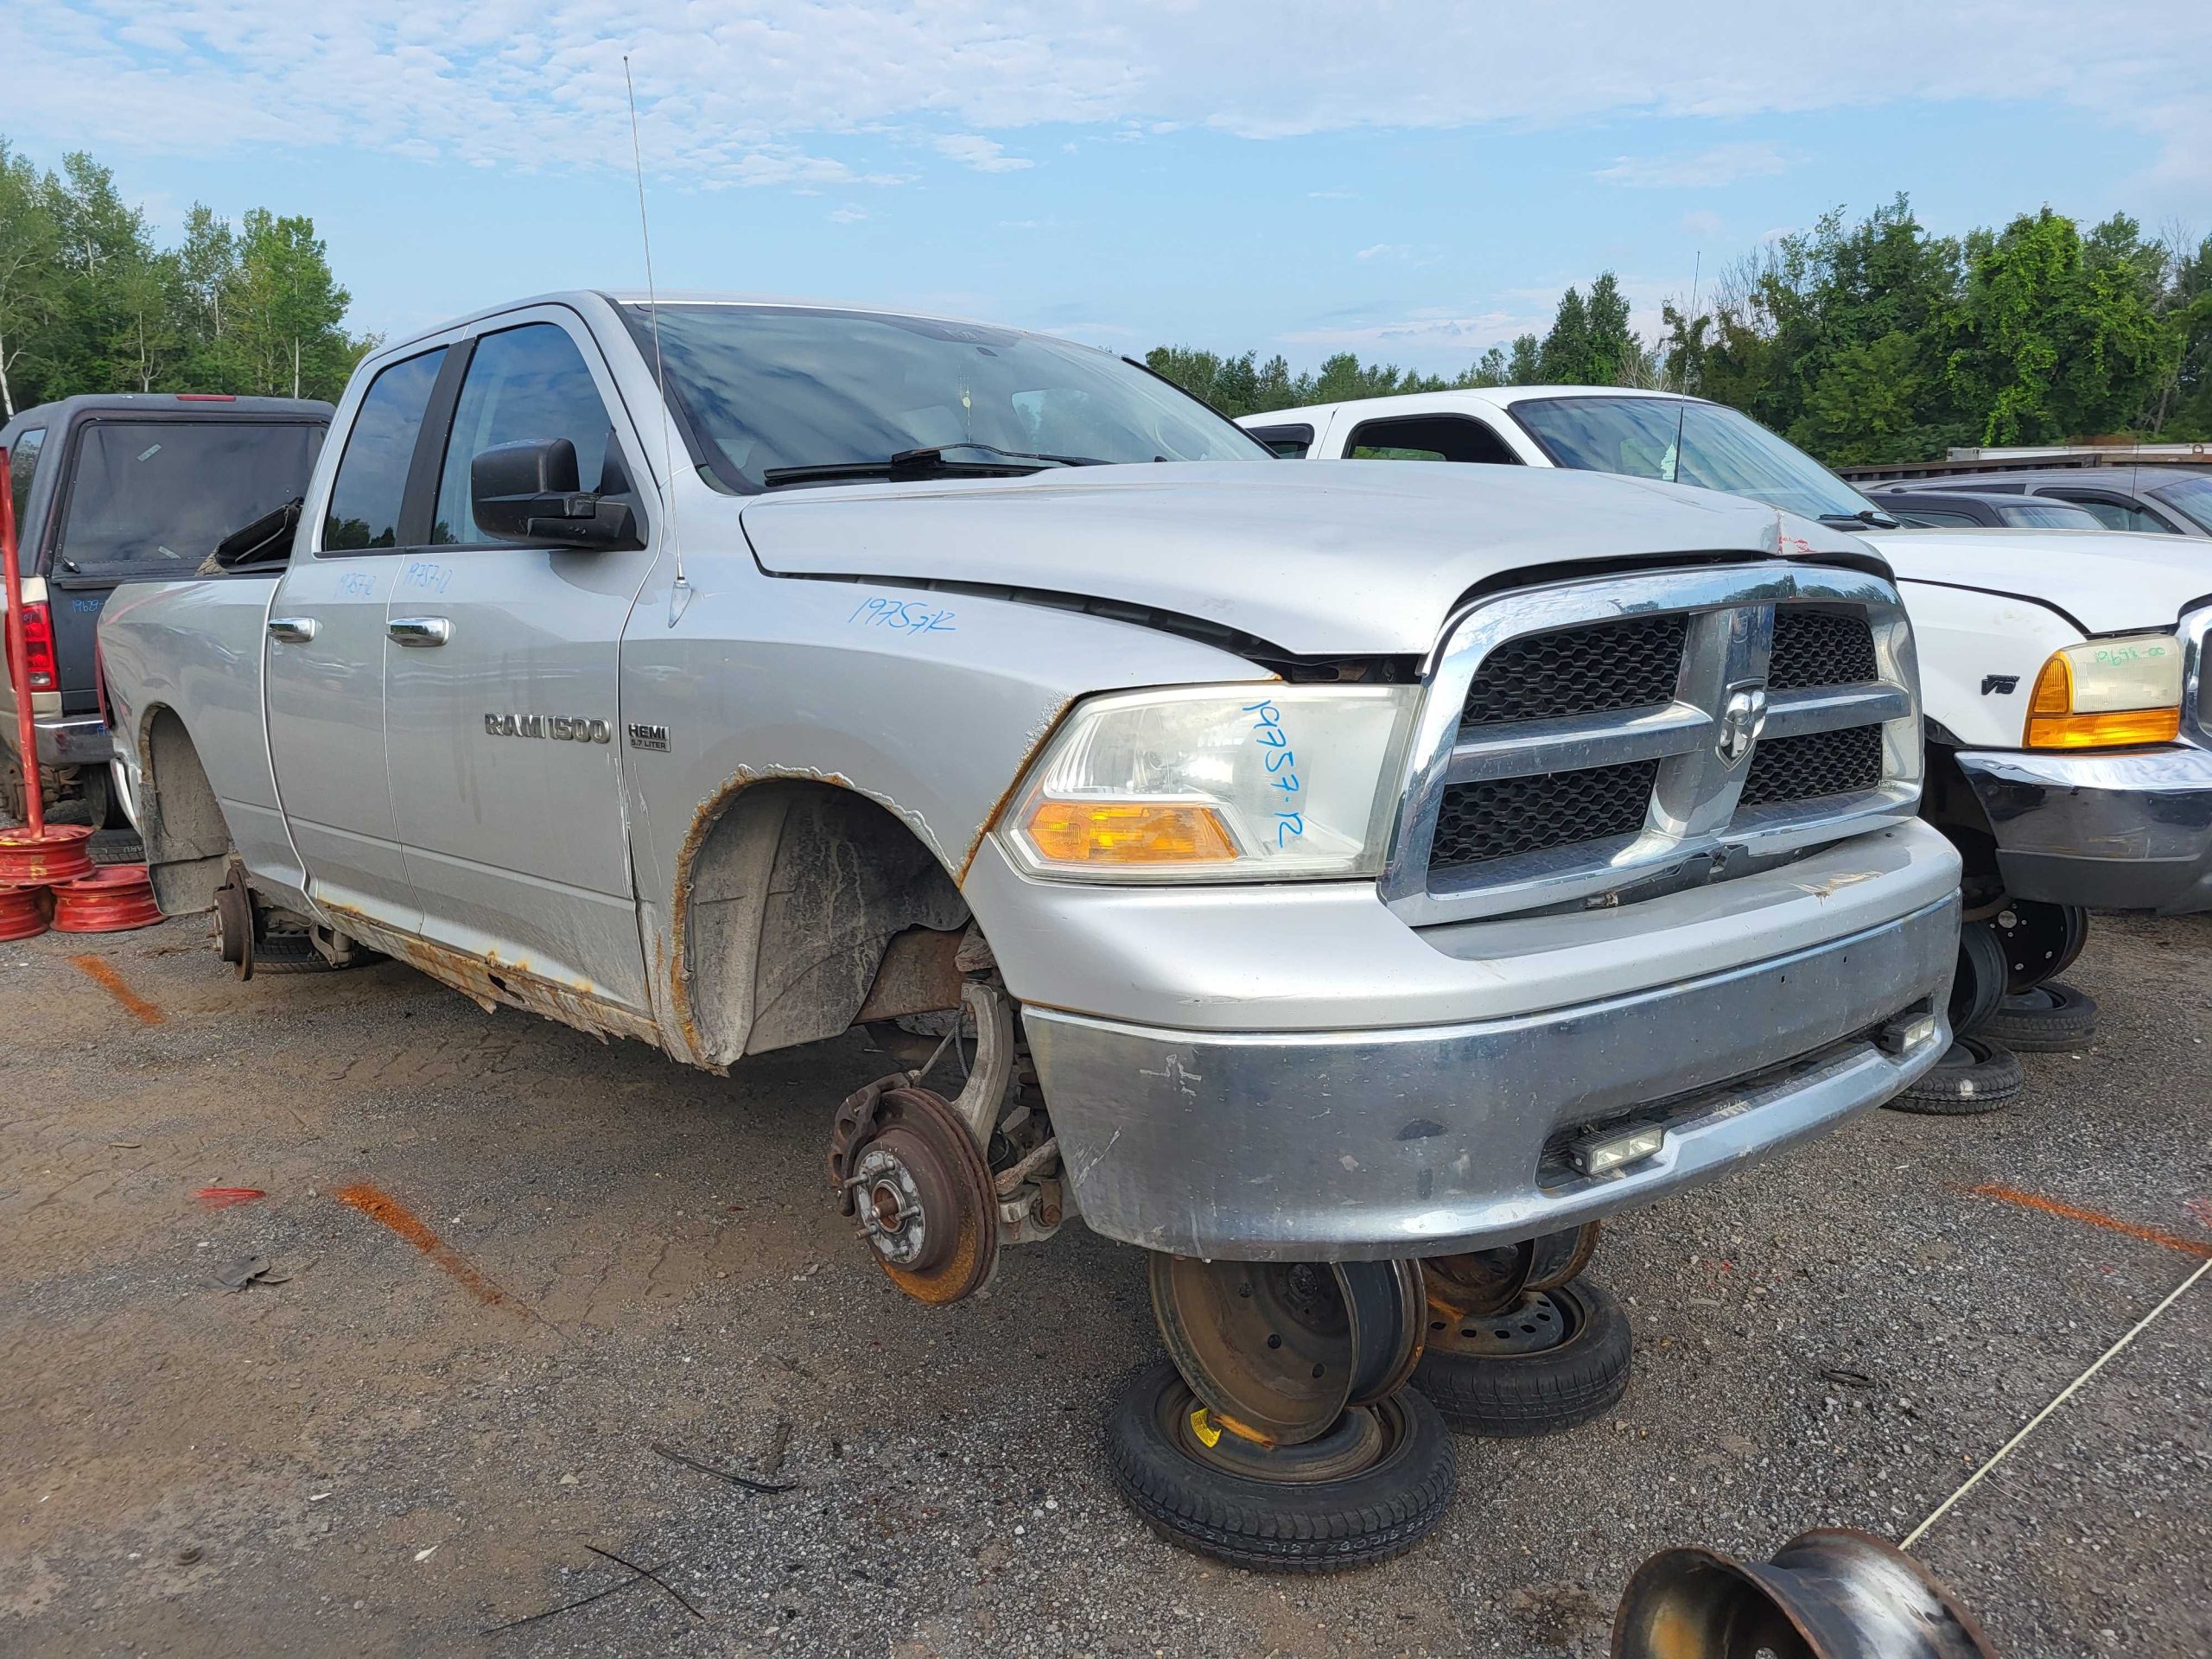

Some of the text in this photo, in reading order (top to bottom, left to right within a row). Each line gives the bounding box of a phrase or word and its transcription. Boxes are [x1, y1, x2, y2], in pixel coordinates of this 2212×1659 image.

[485, 712, 611, 744] RAM 1500
[628, 722, 667, 740] HEMI
[644, 741, 666, 750] LITER
